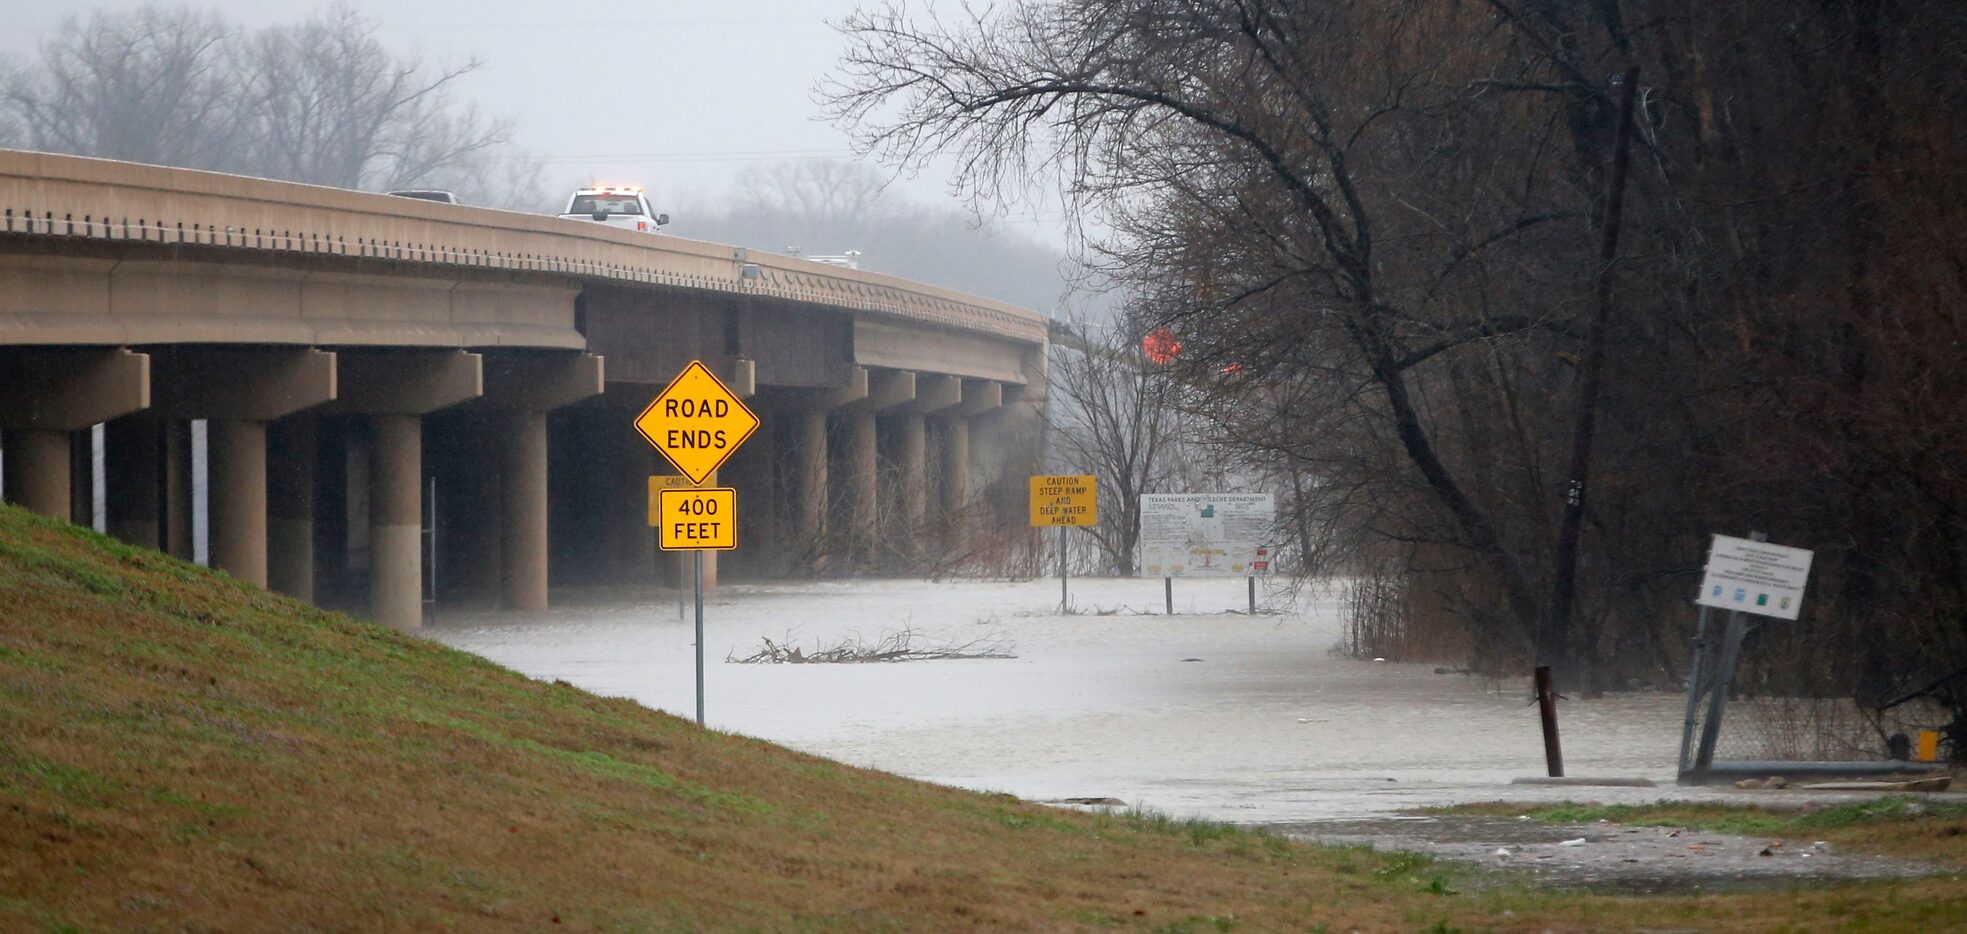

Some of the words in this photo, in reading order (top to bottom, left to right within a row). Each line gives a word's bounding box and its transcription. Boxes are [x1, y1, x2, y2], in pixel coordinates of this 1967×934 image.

[665, 399, 729, 418] ROAD
[667, 430, 727, 449] ENDS
[665, 477, 693, 486] CAUTI
[1046, 477, 1079, 485] CAUTION
[1039, 487, 1063, 495] STEEP
[1065, 487, 1087, 495] RAMP
[1056, 497, 1071, 505] AND
[678, 499, 718, 516] 400
[1040, 506, 1060, 515] DEEP
[1063, 506, 1087, 515] WATER
[1051, 516, 1077, 525] AHEAD
[674, 522, 721, 539] FEET
